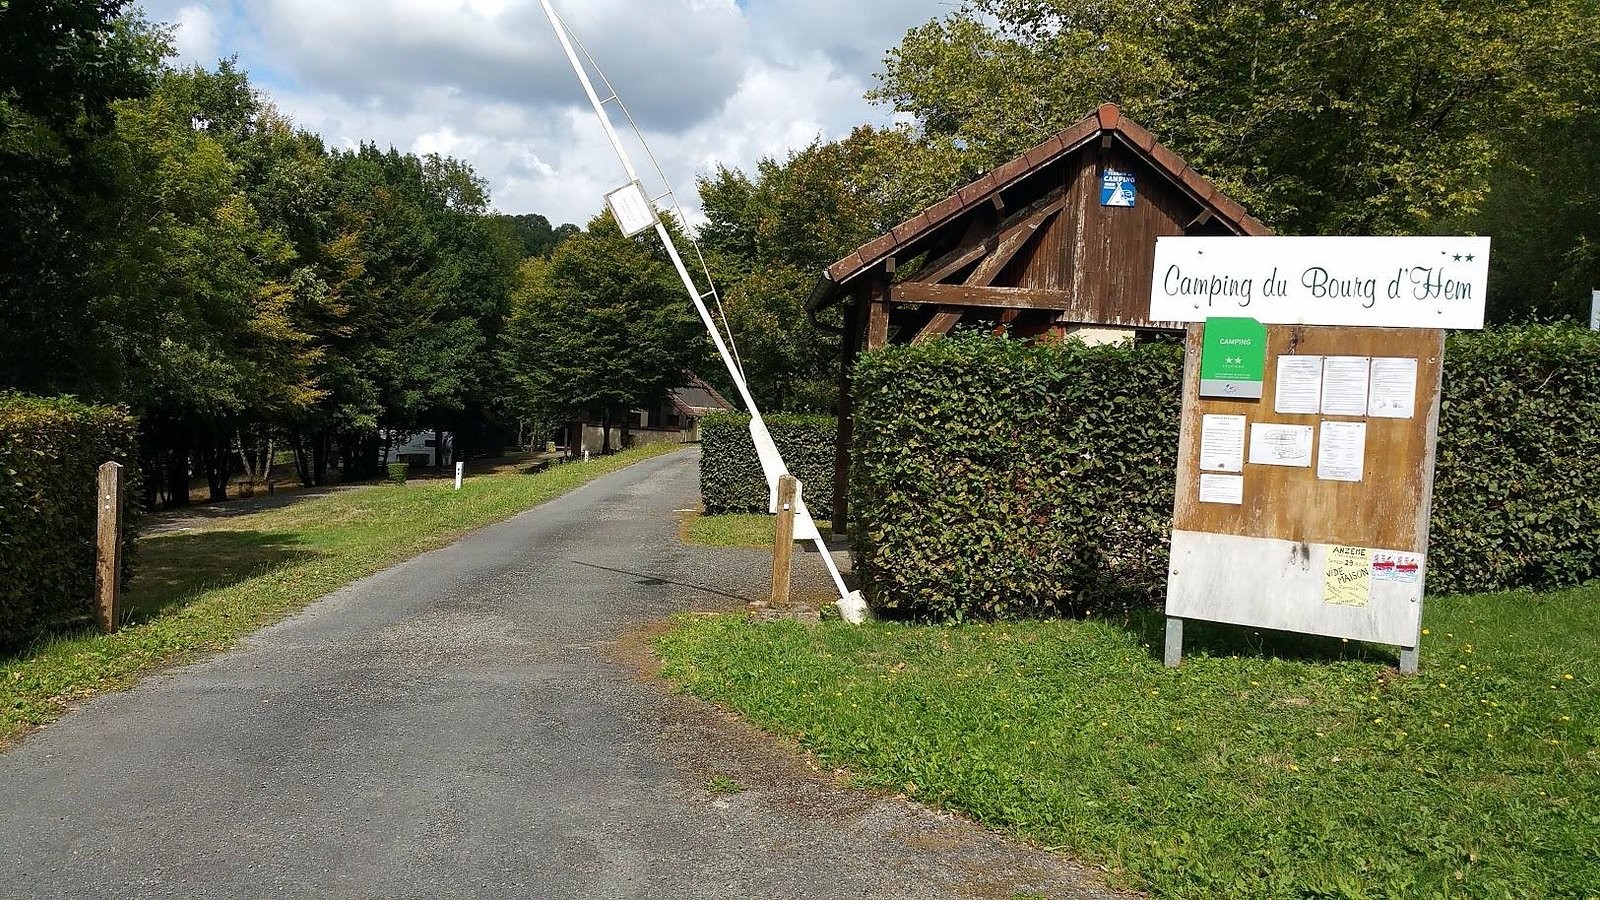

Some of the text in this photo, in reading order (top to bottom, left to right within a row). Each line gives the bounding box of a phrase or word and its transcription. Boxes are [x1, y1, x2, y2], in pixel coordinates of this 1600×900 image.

[1163, 264, 1472, 309] Camping du Bourg d'Hem
[1219, 338, 1251, 346] CAMPING
[1332, 546, 1366, 556] ANZEME
[1344, 559, 1354, 567] 29
[1325, 566, 1345, 577] VIDE
[1337, 567, 1370, 584] MAISON
